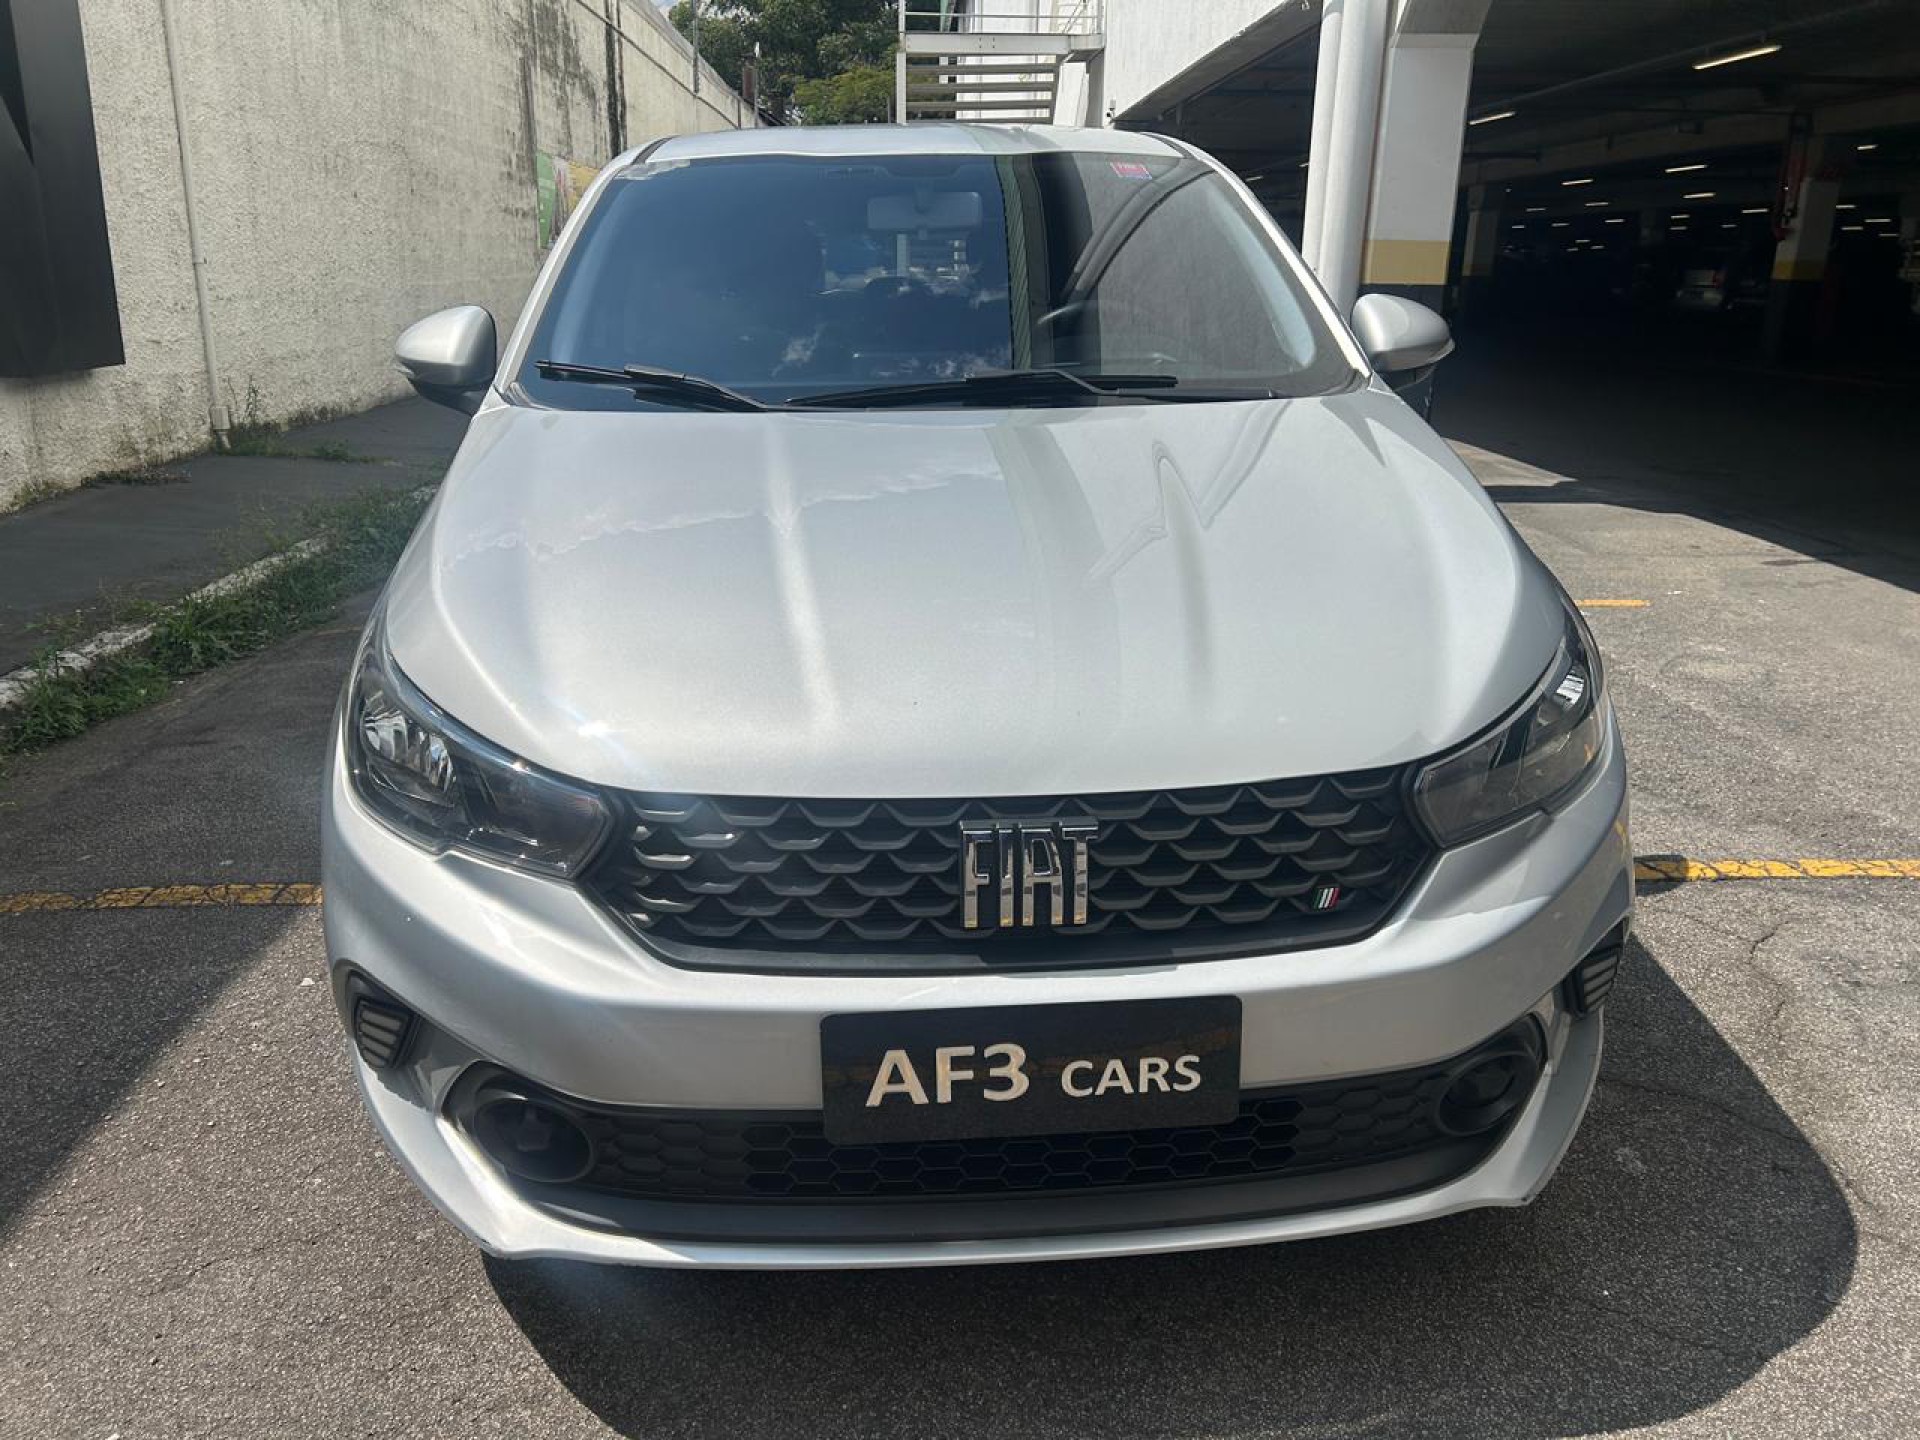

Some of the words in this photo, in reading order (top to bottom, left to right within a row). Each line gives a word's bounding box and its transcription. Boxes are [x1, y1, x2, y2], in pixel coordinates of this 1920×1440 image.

[960, 819, 1098, 928] FIAT
[865, 1043, 1030, 1107] AF3
[1061, 1055, 1201, 1098] CARS
